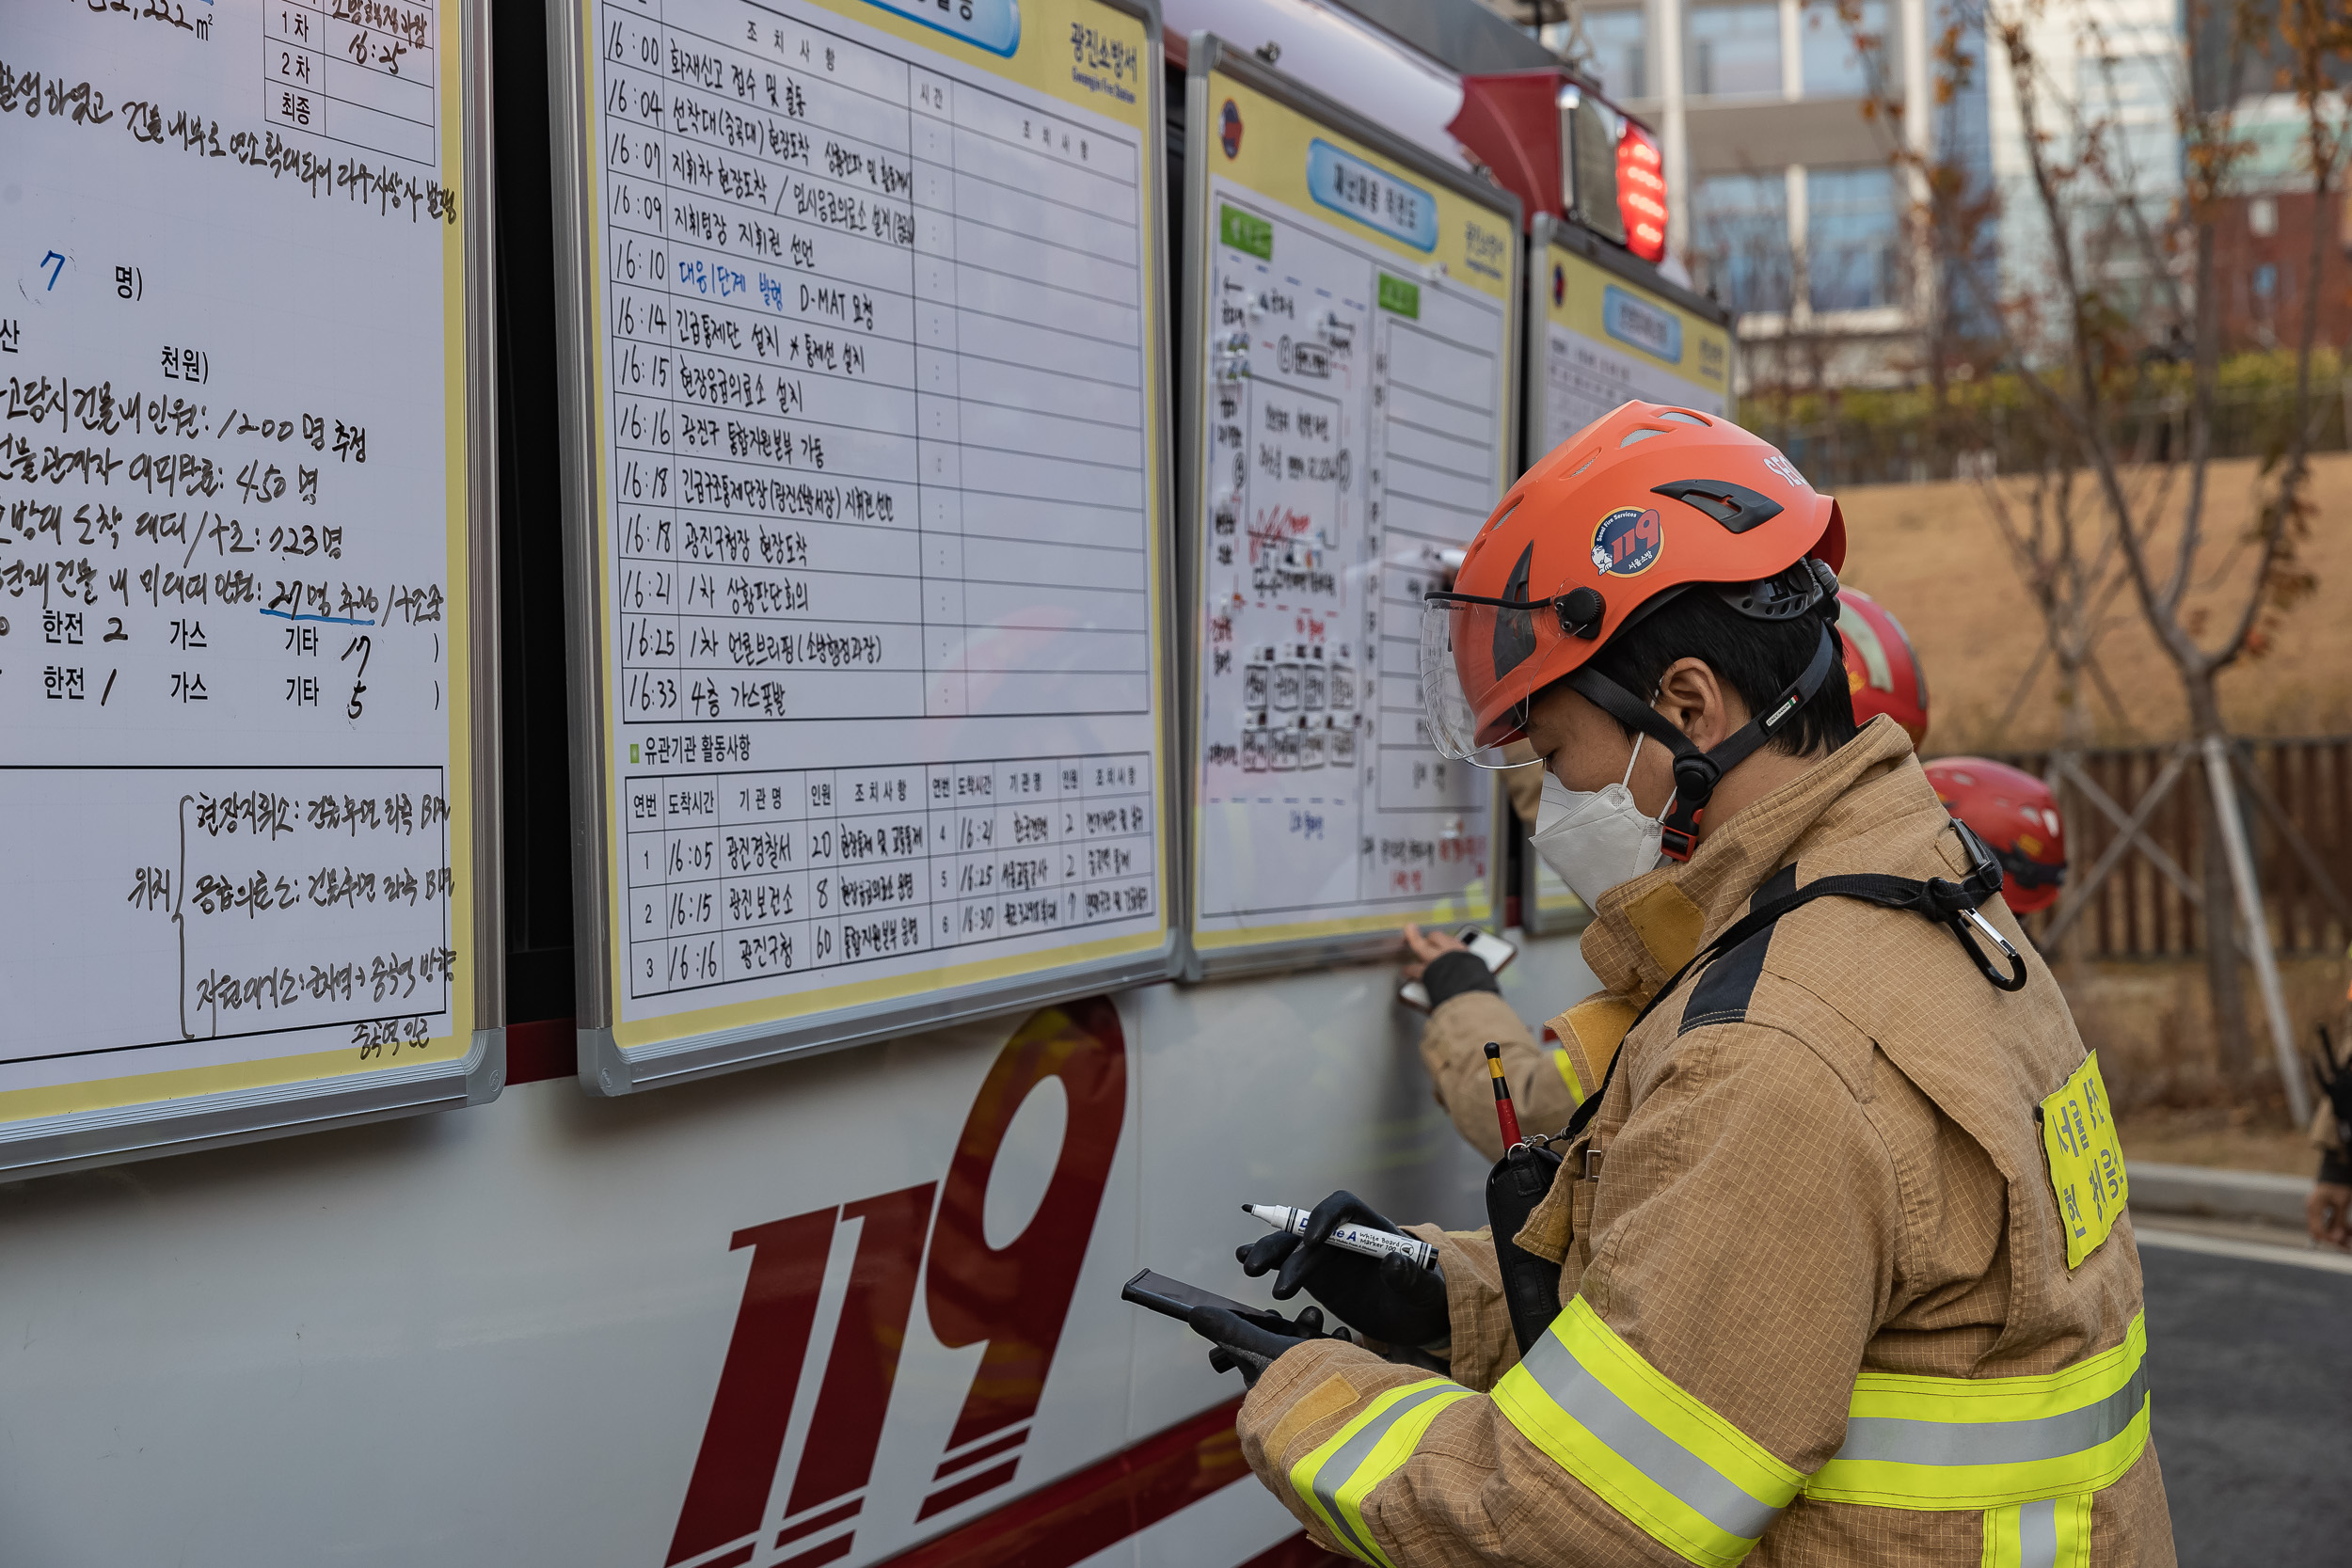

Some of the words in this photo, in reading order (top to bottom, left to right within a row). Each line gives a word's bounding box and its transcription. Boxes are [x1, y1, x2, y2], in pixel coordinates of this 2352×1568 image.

[349, 30, 407, 75] 16:25
[608, 21, 660, 66] 16:00
[731, 64, 756, 102] 접수
[282, 92, 310, 125] 최종
[608, 79, 663, 128] 16:04
[611, 133, 661, 180] 16:07
[672, 150, 714, 188] 지휘차
[718, 157, 768, 205] 현장도착
[613, 184, 662, 233] 16:09
[738, 222, 784, 259] 지휘권
[40, 249, 66, 292] 7
[616, 239, 666, 281] 16:10
[617, 296, 668, 336] 16:14
[751, 323, 780, 357] 설치
[160, 344, 209, 385] 천원)
[621, 344, 671, 388] 16:15
[776, 376, 803, 414] 설치
[620, 404, 672, 447] 16:16
[623, 461, 670, 500] 16:18
[1603, 517, 1614, 528] Fire
[1613, 511, 1637, 520] Services
[1611, 508, 1660, 565] 119
[625, 513, 673, 555] 16:18
[758, 524, 808, 567] 현장도착
[1628, 549, 1654, 570] 서울소방
[623, 568, 672, 610] 16:21
[42, 610, 85, 645] 한전
[103, 617, 129, 643] 2
[169, 619, 208, 651] 가스
[285, 626, 319, 657] 기타
[627, 617, 675, 662] 16:25
[43, 666, 85, 701] 한전
[170, 671, 209, 704] 가스
[286, 676, 320, 707] 기타
[347, 679, 367, 720] 5
[628, 671, 678, 712] 16:33
[644, 736, 697, 766] 유관기관
[701, 734, 751, 764] 활동사항
[633, 793, 658, 818] 연번
[668, 790, 715, 816] 도착시간
[810, 784, 832, 807] 인원
[960, 816, 993, 850] 16:21
[643, 849, 650, 870] 1
[669, 838, 714, 877] 16:05
[811, 831, 833, 860] 20
[127, 867, 171, 912] 위치
[960, 863, 994, 892] 16:25
[644, 904, 653, 924] 2
[669, 892, 713, 930] 16:15
[816, 878, 829, 910] 8
[961, 905, 994, 934] 16:30
[645, 957, 654, 978] 3
[669, 941, 717, 982] 16:16
[816, 926, 832, 959] 60
[1346, 1230, 1358, 1243] A
[1359, 1232, 1379, 1243] White
[1381, 1237, 1401, 1248] Board
[1359, 1238, 1384, 1249] Marker
[664, 992, 1128, 1568] 119
